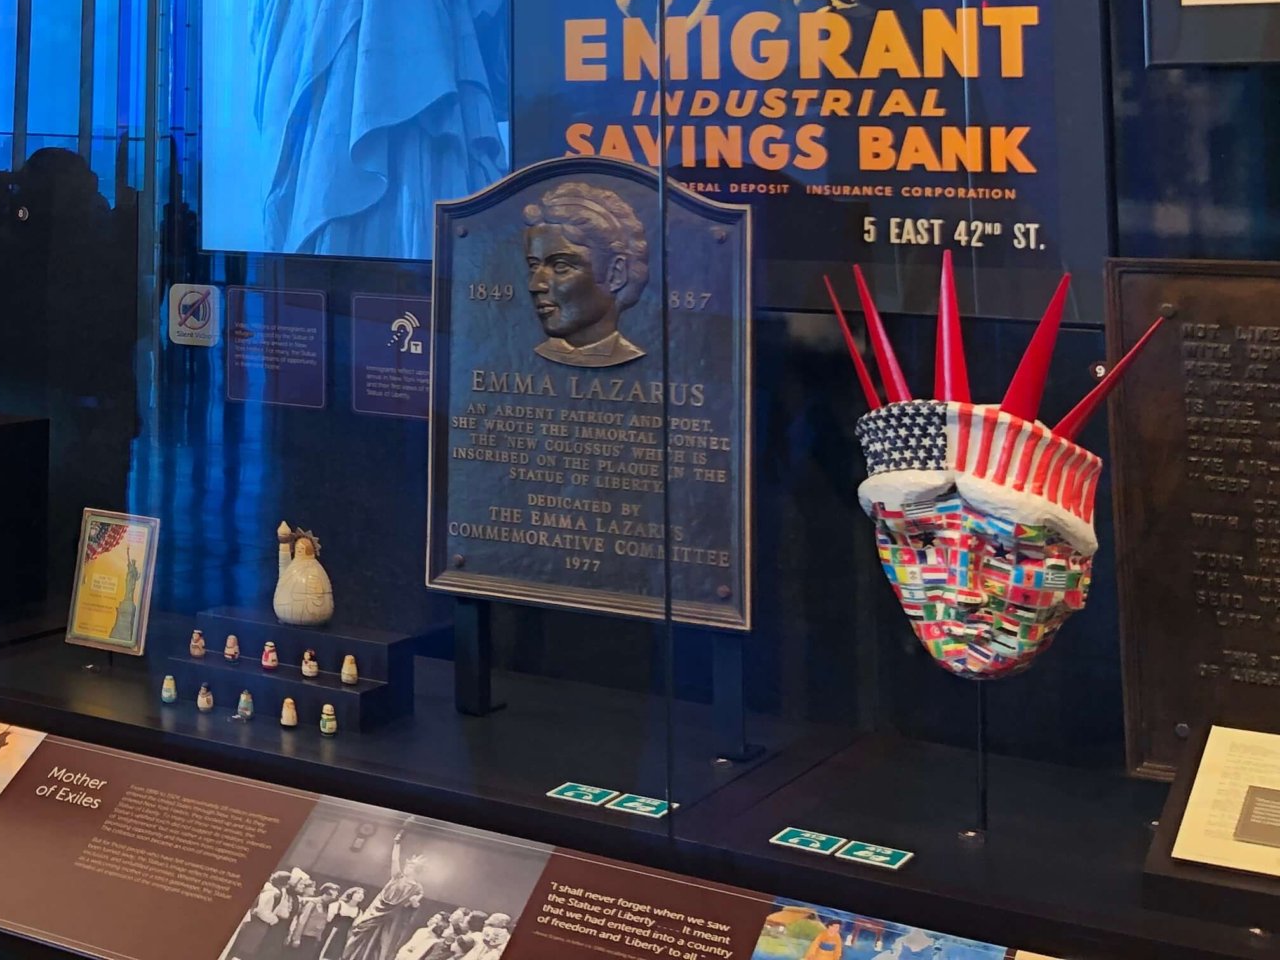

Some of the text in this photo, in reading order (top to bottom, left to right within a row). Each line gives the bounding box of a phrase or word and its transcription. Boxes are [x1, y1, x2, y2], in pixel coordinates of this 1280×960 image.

[564, 6, 1039, 82] EMIGRANT
[631, 88, 949, 118] INDUSTRIAL
[564, 123, 1038, 174] SAVINGS BANK
[729, 183, 790, 194] DEPOSIT
[806, 184, 893, 197] INSURANCE
[901, 186, 1017, 200] CORPORATION
[863, 216, 1046, 250] 5 EAST 42ND ST.
[469, 283, 712, 309] 1849 887
[471, 370, 705, 407] EMMA LAZARUS
[452, 416, 477, 429] SHE
[485, 418, 534, 434] WROTE
[541, 423, 568, 437] THE
[575, 425, 657, 445] IMMORTAL
[467, 403, 487, 415] AN
[495, 405, 555, 420] ARDENT
[561, 408, 625, 426] PATRIOT
[629, 414, 663, 428] AND
[452, 446, 529, 465] INSCRIBED
[536, 454, 557, 466] ON
[563, 456, 590, 471] THE
[597, 460, 660, 477] PLAQUE
[693, 468, 727, 483] THE
[470, 433, 497, 447] THE
[632, 447, 686, 464] WHIH
[693, 452, 708, 465] IS
[508, 466, 564, 484] STATUE
[571, 474, 590, 486] OF
[489, 505, 523, 523] THE
[531, 510, 589, 531] EMMA
[527, 493, 642, 516] DEDICATED BY
[448, 521, 605, 553] COMMEMORATIVE
[565, 556, 601, 572] 1977
[47, 765, 108, 791] Mother
[36, 784, 102, 810] of Exiles
[547, 893, 732, 945] the Statue of Liberty It meant
[559, 884, 584, 897] shall
[584, 892, 617, 905] never
[617, 897, 652, 914] forget
[653, 907, 685, 921] when
[687, 915, 705, 926] we
[707, 920, 732, 932] saw
[537, 915, 551, 924] of
[551, 917, 598, 937] freedom
[598, 929, 622, 943] and
[668, 947, 681, 958] to
[542, 904, 734, 959] that we had entered into a country
